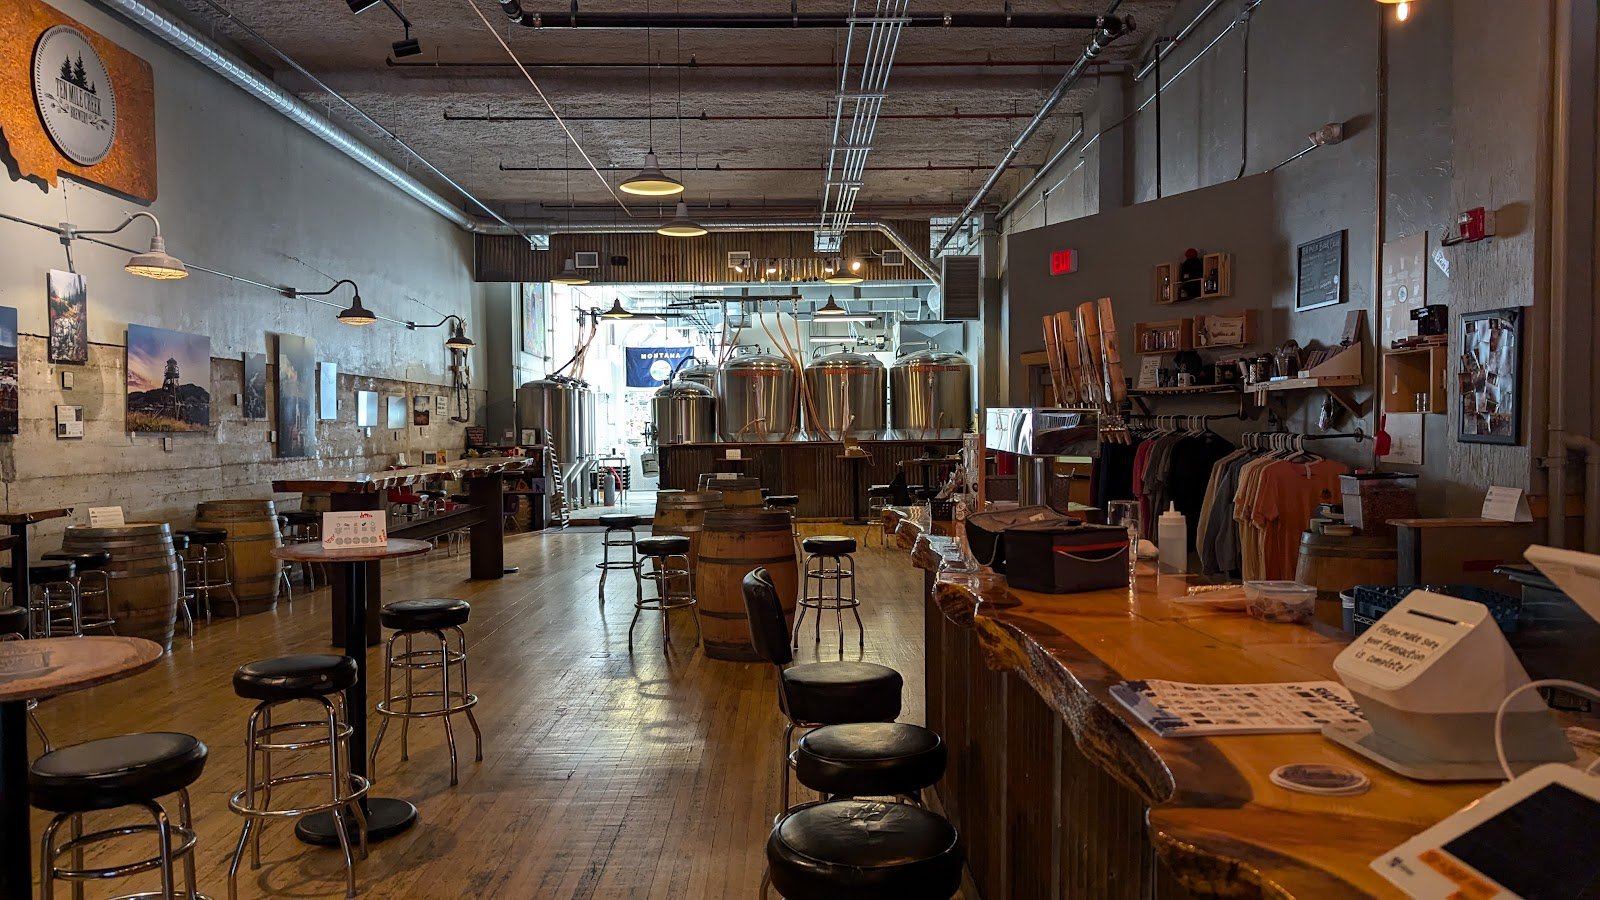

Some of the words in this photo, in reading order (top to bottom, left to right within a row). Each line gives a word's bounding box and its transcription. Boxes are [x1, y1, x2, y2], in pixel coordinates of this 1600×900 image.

[55, 77, 68, 100] TEN
[69, 83, 83, 108] MILE
[84, 92, 102, 116] CREEK
[640, 352, 681, 360] MONTANA
[1364, 636, 1383, 645] your
[1380, 640, 1425, 660] transaction
[1376, 623, 1400, 637] Please
[1401, 630, 1422, 643] make
[1421, 638, 1439, 649] sure
[1355, 649, 1366, 659] is
[1366, 655, 1413, 673] complete!
